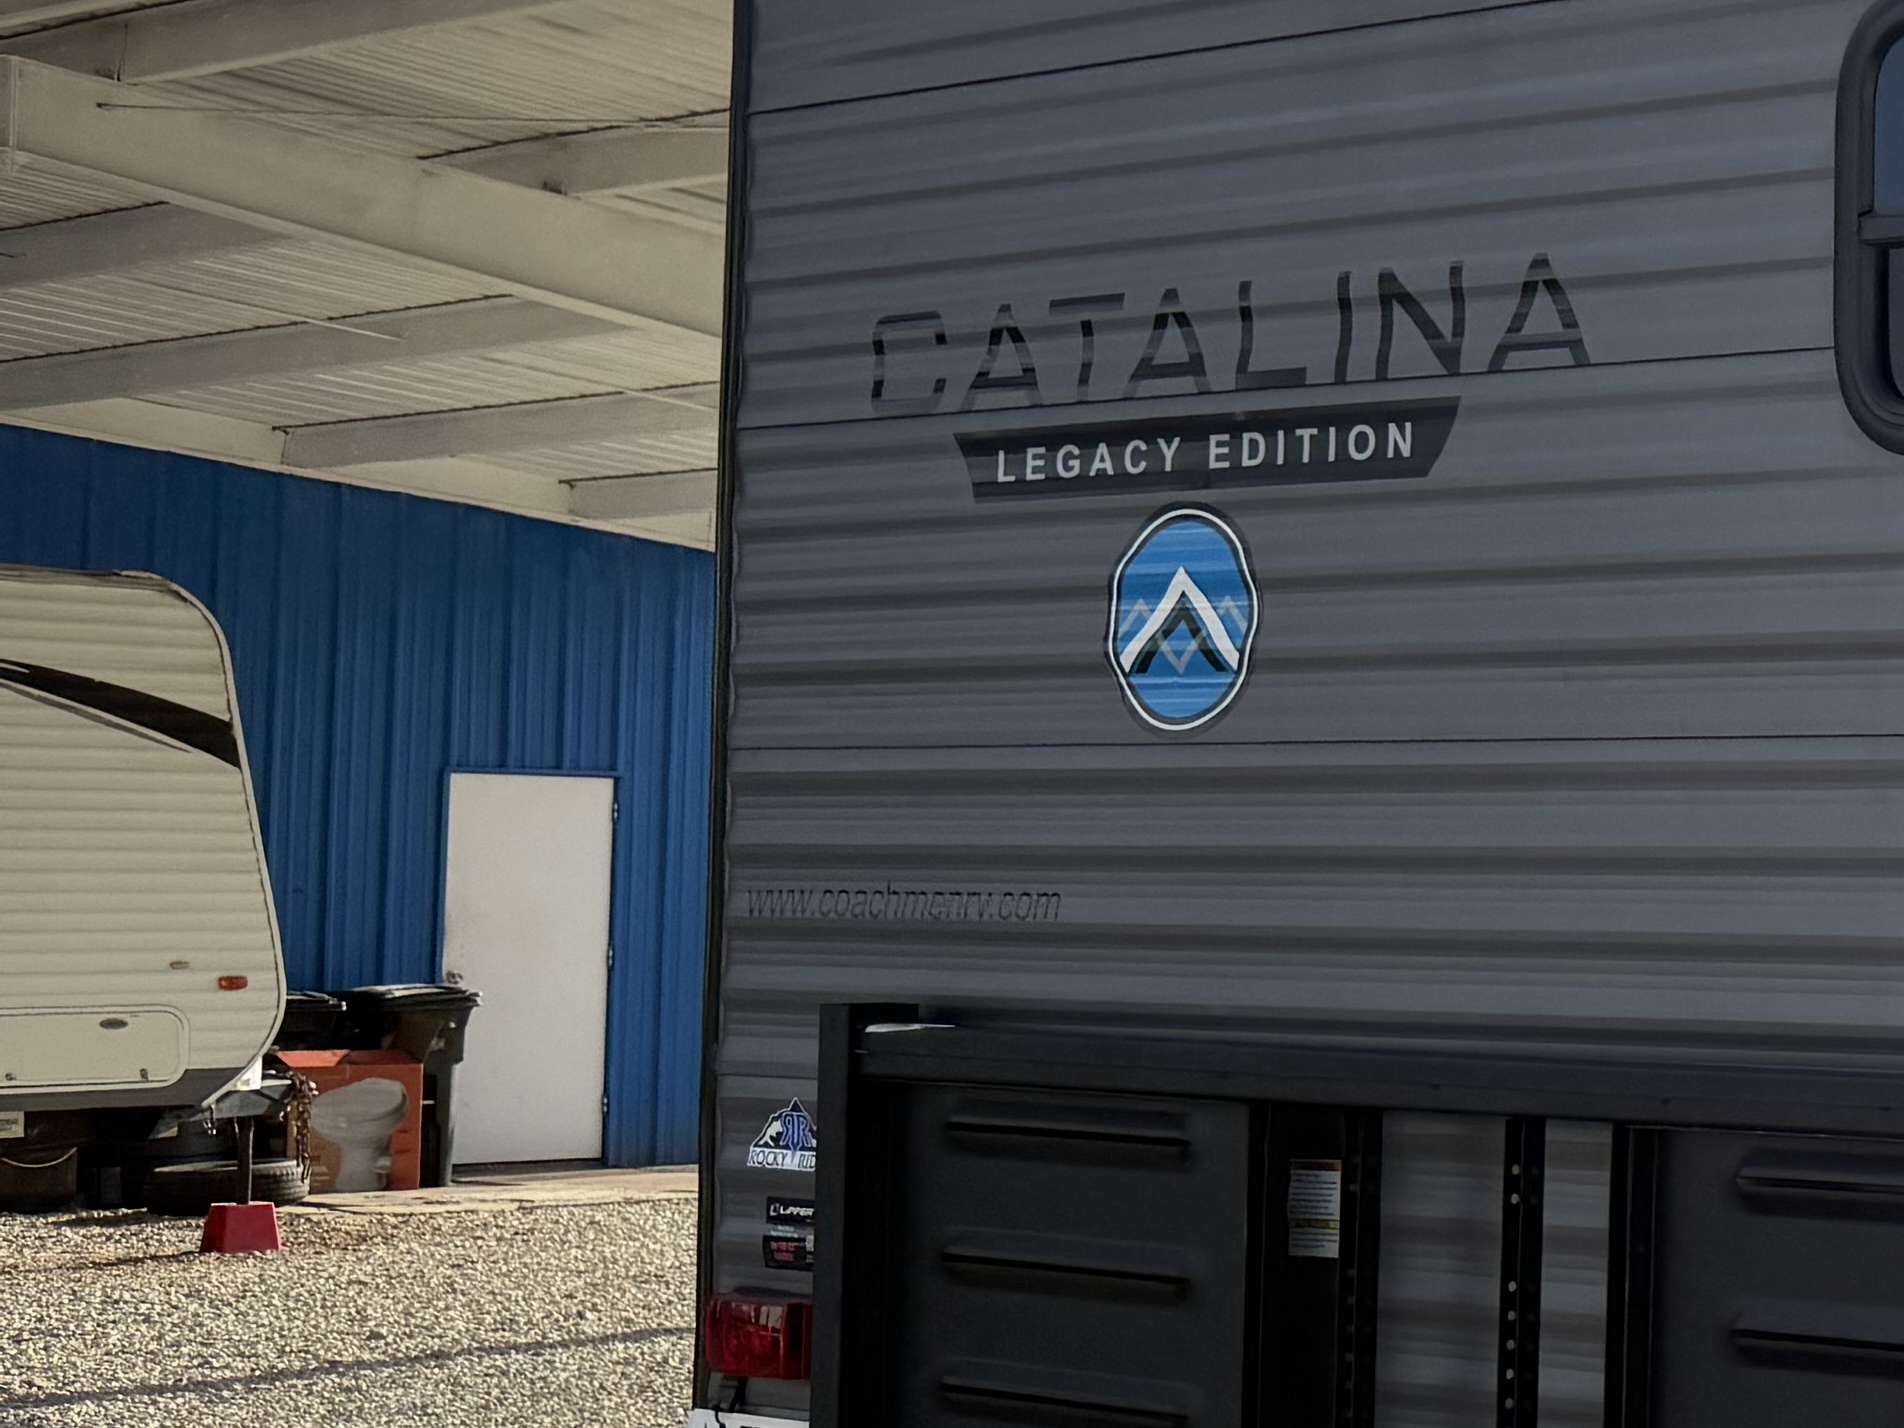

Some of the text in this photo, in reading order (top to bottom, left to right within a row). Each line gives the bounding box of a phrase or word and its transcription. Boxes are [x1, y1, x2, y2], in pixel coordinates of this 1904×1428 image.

[870, 252, 1592, 413] CATALINA
[997, 421, 1414, 484] LEGACY EDITION
[748, 880, 1062, 921] www.coachmenrv.com
[748, 1149, 816, 1170] ROCKY RID
